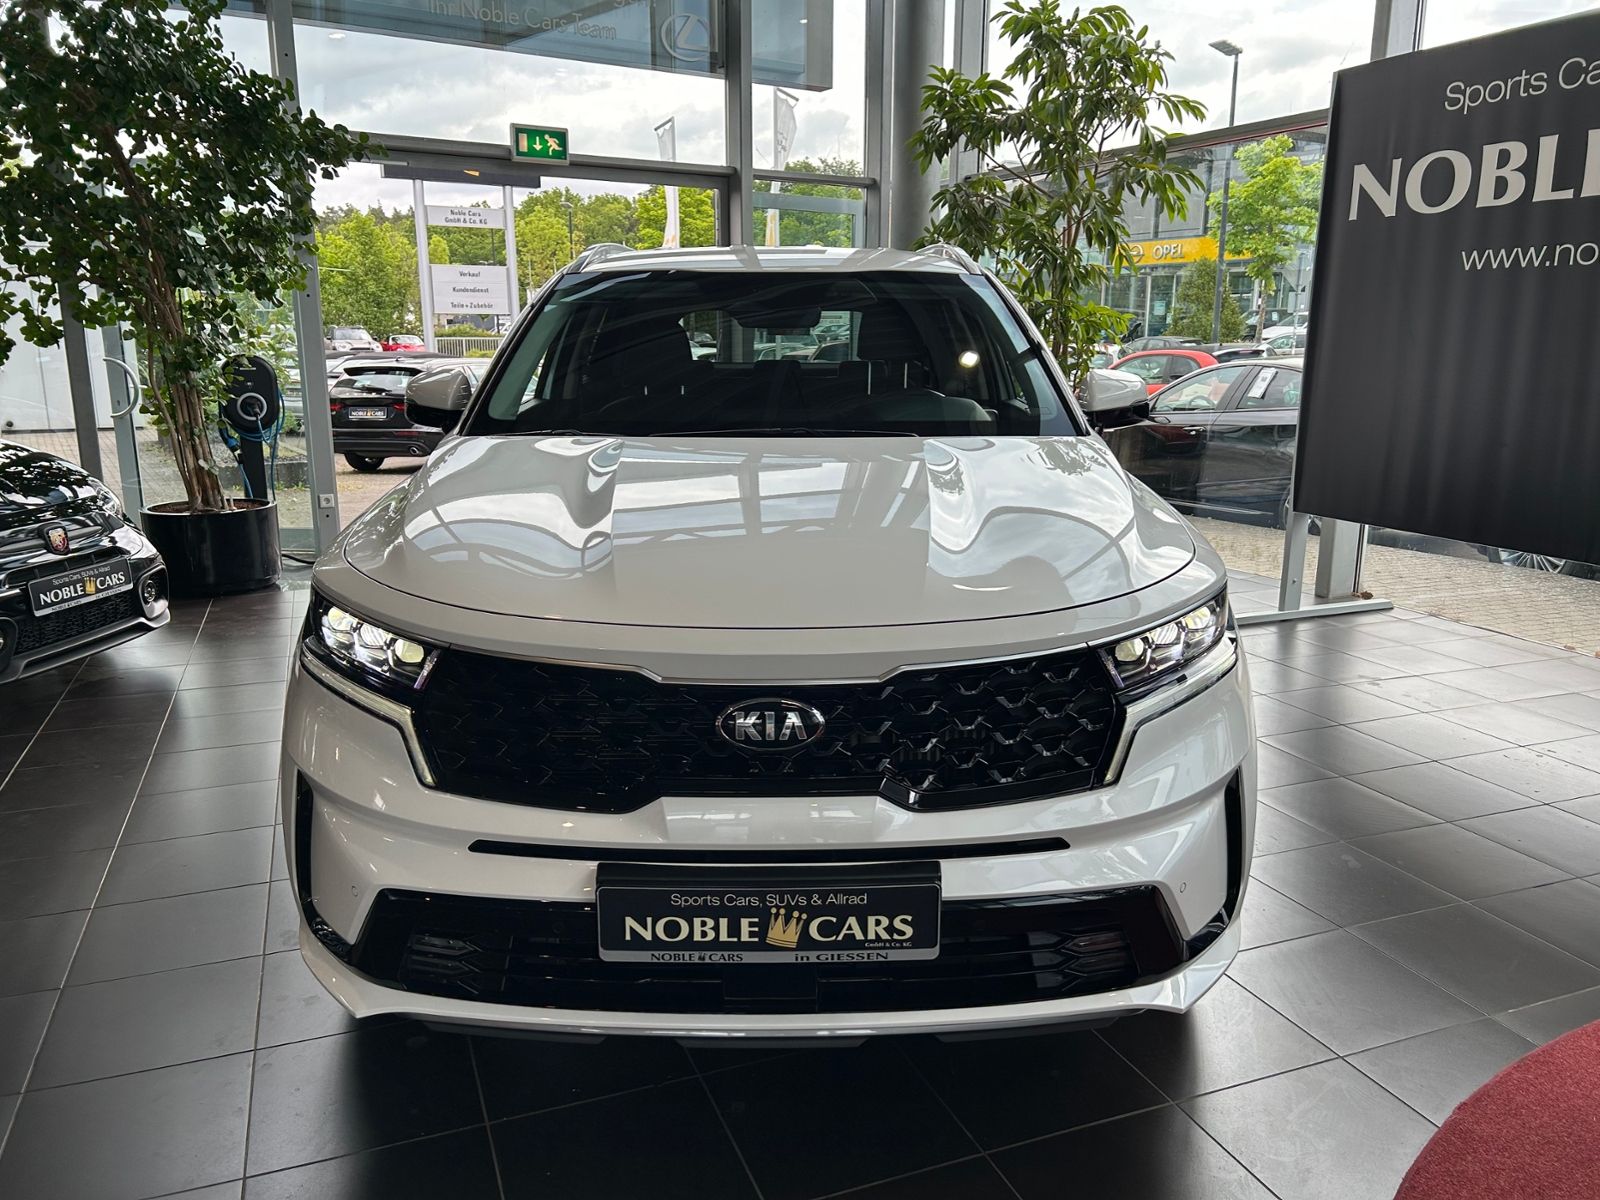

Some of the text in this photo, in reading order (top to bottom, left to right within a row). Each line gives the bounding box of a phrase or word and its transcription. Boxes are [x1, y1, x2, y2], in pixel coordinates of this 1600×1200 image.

[460, 0, 519, 25] Noble
[524, 7, 567, 32] Cars
[573, 13, 617, 41] Team
[1444, 69, 1548, 115] Sports
[450, 209, 481, 218] Noble Cars
[1152, 244, 1184, 259] OPEL
[469, 302, 494, 310] Zubehör
[39, 583, 85, 605] NOBLE
[96, 571, 125, 588] CARS
[732, 711, 808, 740] KIA
[670, 893, 868, 908] Sports Cars, SUVs & Allrad
[624, 915, 914, 942] NOBLE CARS
[650, 952, 743, 962] NOBLE CARS
[794, 952, 889, 962] in GIESSEN
